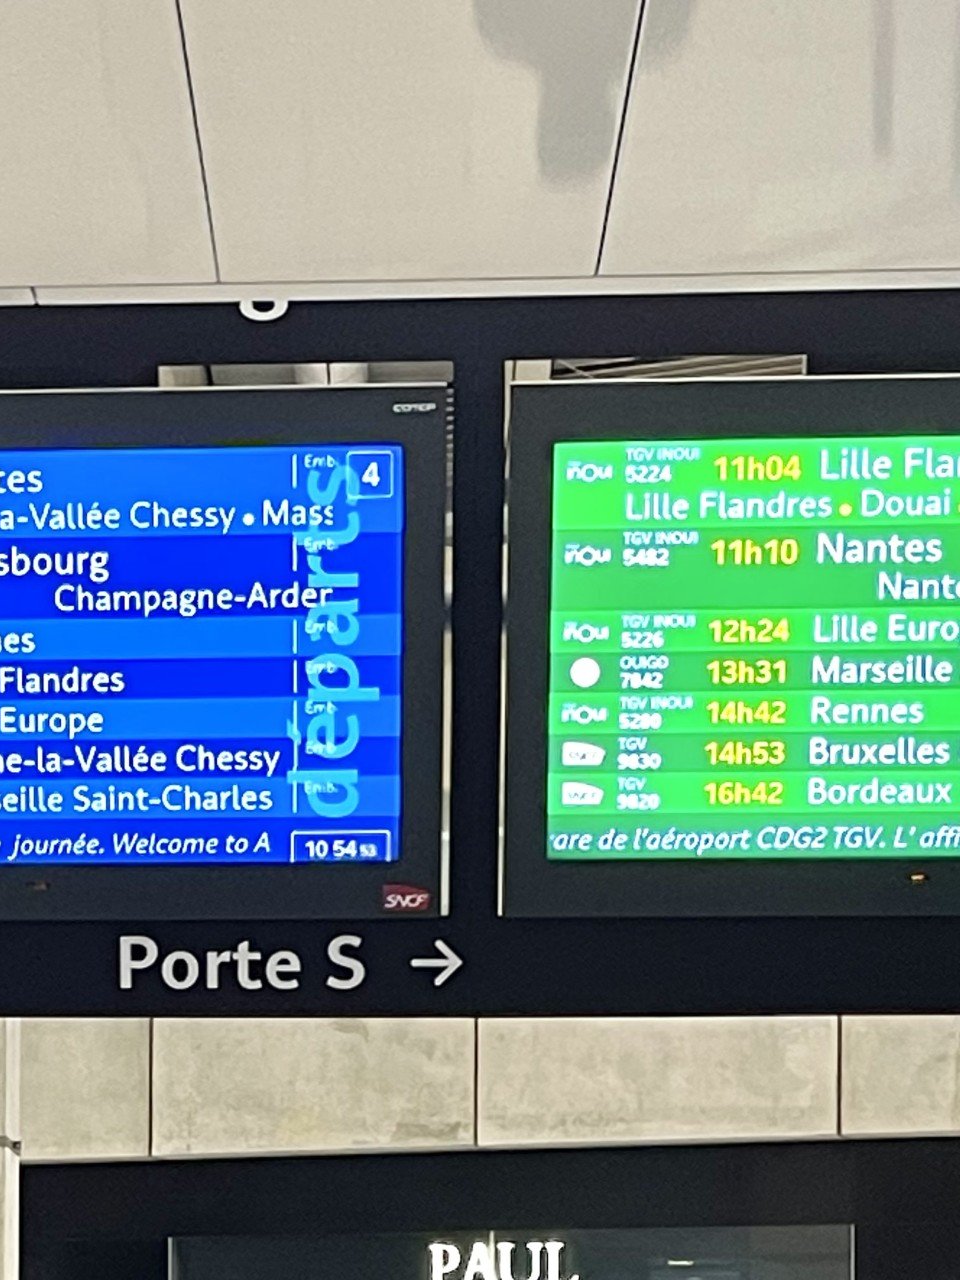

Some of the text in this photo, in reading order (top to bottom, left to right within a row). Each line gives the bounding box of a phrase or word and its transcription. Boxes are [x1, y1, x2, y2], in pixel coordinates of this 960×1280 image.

[626, 447, 654, 461] TGV
[713, 447, 960, 482] 11h04 Lille Fla
[361, 462, 381, 487] 4
[625, 465, 672, 484] 5224
[130, 501, 236, 534] Chessy
[263, 499, 334, 527] Mass
[625, 488, 951, 521] Lille Flandres Douai
[623, 532, 651, 545] TGV
[711, 532, 942, 566] 11h10 Nantes
[878, 571, 960, 600] Nant
[621, 614, 650, 629] TGV
[708, 618, 790, 643] 12h24
[814, 614, 878, 643] Lille
[0, 665, 124, 695] Flandres
[706, 655, 953, 685] 13h31 Marseille
[619, 696, 648, 711] TGV
[706, 696, 925, 725] 14h42 Rennes
[0, 705, 103, 740] Europe
[617, 737, 647, 751] TGV
[704, 736, 951, 766] 14h53 Bruxelles
[176, 746, 280, 778] Chessy
[74, 785, 273, 813] Saint-Charles
[704, 776, 952, 806] 16h42 Bordeaux
[8, 833, 105, 861] journée.
[112, 832, 219, 855] Welcome
[226, 833, 249, 855] to
[253, 832, 271, 855] A
[305, 839, 329, 858] 10
[333, 839, 357, 858] 54
[550, 833, 593, 851] are
[598, 828, 628, 851] de
[633, 827, 751, 856] l'aéroport
[756, 826, 829, 850] CDG2
[833, 826, 886, 850] TGV.
[384, 892, 430, 909] SNCF
[119, 935, 366, 990] Porte S
